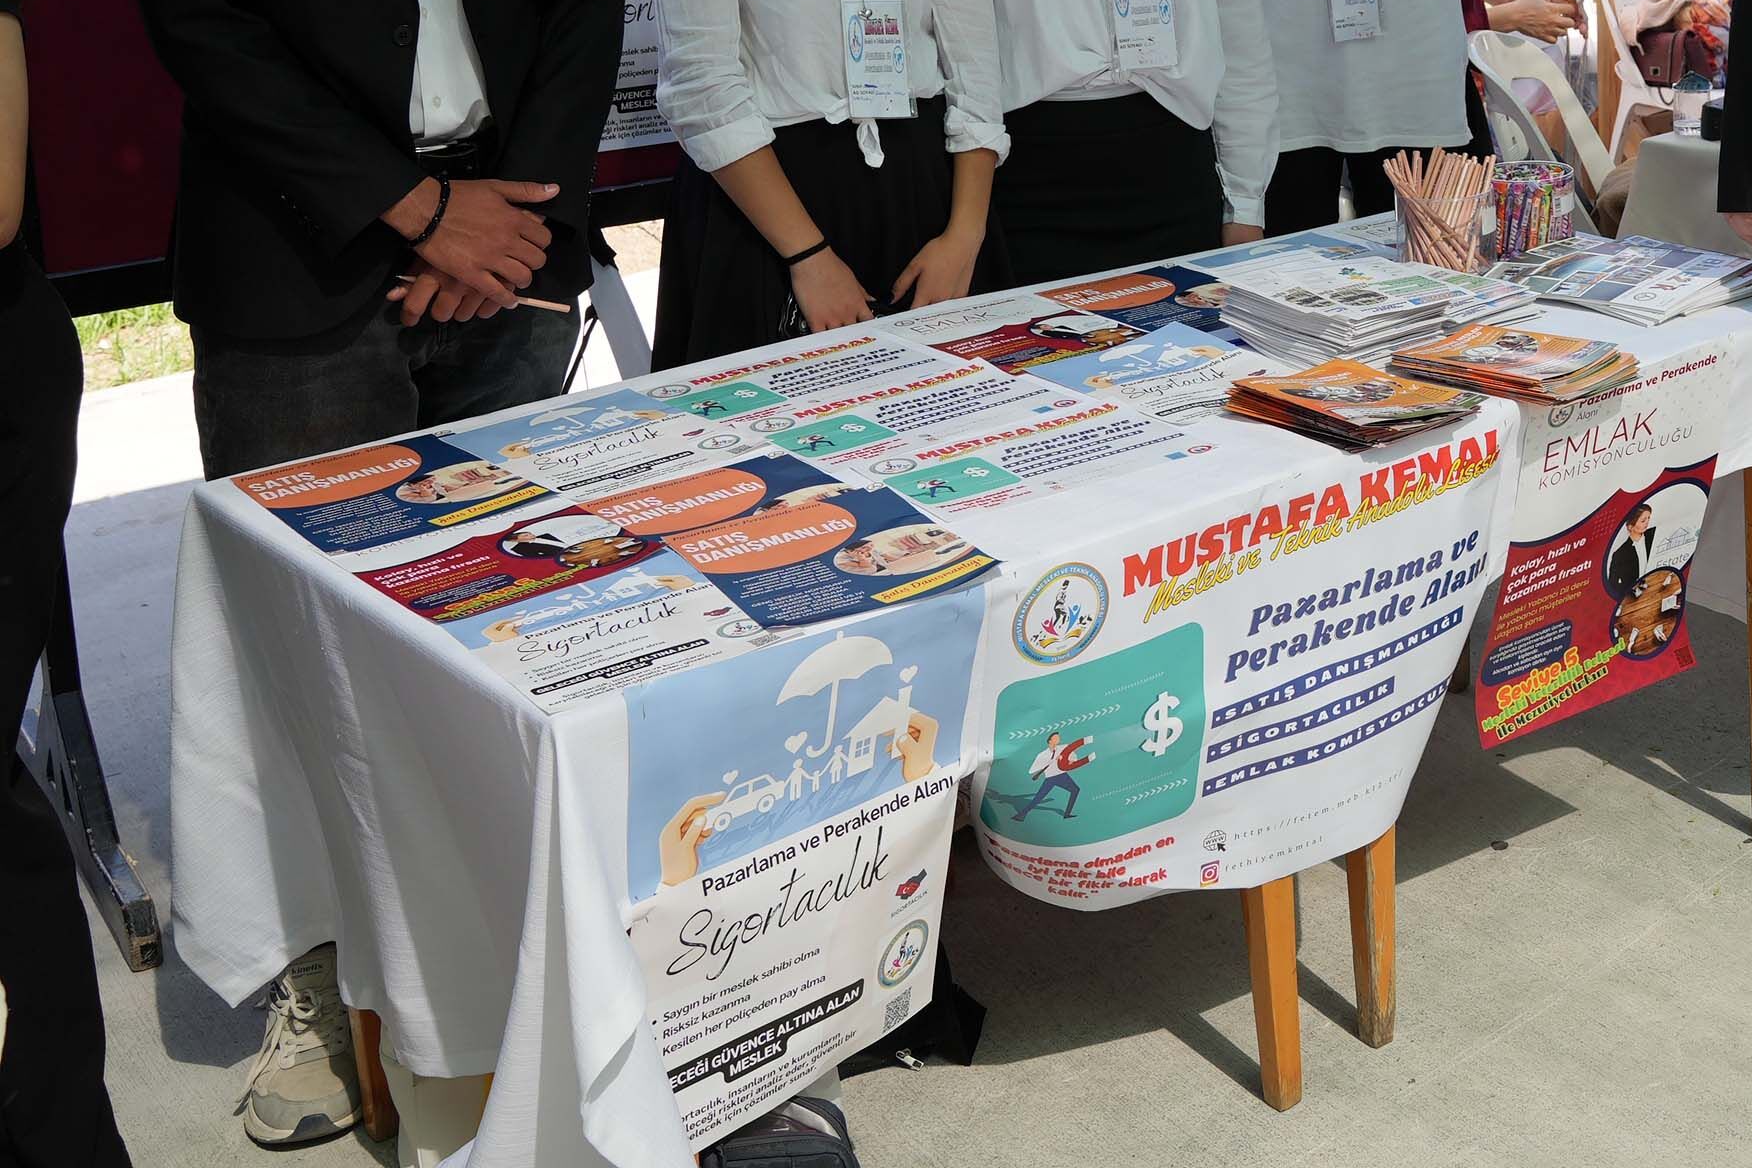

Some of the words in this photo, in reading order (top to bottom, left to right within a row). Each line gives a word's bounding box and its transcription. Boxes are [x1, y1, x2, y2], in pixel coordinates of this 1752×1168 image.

[1578, 382, 1643, 409] Pazarlama
[1645, 376, 1658, 387] ve
[1661, 354, 1718, 381] Perakende
[915, 426, 1035, 461] MUSTAFA
[1538, 425, 1693, 490] KOMİSYONCULUĞU
[1543, 407, 1658, 473] EMLAK
[259, 457, 420, 502] DANIŞMANLIĞI
[608, 481, 767, 527] DANIŞMANLIĞI
[691, 519, 855, 565] DANIŞMANLIĞI
[1122, 483, 1351, 597] MUSTAFA
[1359, 428, 1502, 506] KEMAL
[1144, 551, 1234, 623] Mesleki
[1237, 552, 1262, 577] ve
[1269, 516, 1344, 560] Teknik
[1346, 474, 1435, 535] Anadolu
[1437, 444, 1501, 495] Lisesi
[1247, 548, 1443, 637] Pazarlama
[1450, 529, 1480, 562] ve
[1503, 576, 1556, 605] kazanma
[1557, 560, 1593, 581] fırsatı
[1506, 573, 1532, 594] çok
[1530, 562, 1558, 585] para
[1510, 554, 1545, 578] Kolay,
[1547, 544, 1572, 560] hızlı
[1573, 537, 1587, 551] ve
[517, 602, 683, 662] Sigortacılık
[1223, 593, 1416, 684] Perakende
[1224, 684, 1296, 720] SATIŞ
[1304, 612, 1460, 690] DANIŞMANLIĞI
[1497, 662, 1562, 710] Seviye
[1563, 645, 1579, 670] 5
[1220, 683, 1389, 754] SİGORTACILIK
[1214, 754, 1296, 789] EMLAK
[702, 844, 796, 896] Pazarlama
[800, 835, 820, 853] ve
[822, 793, 910, 843] Perakende
[913, 775, 955, 802] Alanı
[1084, 844, 1152, 869] olmadan
[1156, 835, 1175, 849] en
[1225, 836, 1324, 872] fethiyemkmtal
[1027, 864, 1049, 876] iyi
[1053, 868, 1090, 879] fikir
[1096, 865, 1127, 879] bile
[1078, 880, 1115, 889] fikir
[1118, 868, 1168, 888] olarak
[666, 825, 890, 981] Sigortacılık
[663, 1000, 700, 1023] Saygın
[702, 992, 718, 1005] bir
[719, 975, 759, 997] meslek
[762, 958, 792, 979] sahibi
[794, 947, 821, 964] olma
[663, 1032, 703, 1056] Kesilen
[704, 1022, 724, 1036] her
[724, 996, 778, 1029] poliçeden
[780, 986, 799, 1004] pay
[800, 975, 826, 991] alma
[663, 1016, 700, 1039] Risksiz
[702, 994, 751, 1021] kazanma
[711, 1030, 775, 1069] GÜVENCE
[776, 1005, 824, 1038] ALTINA
[825, 986, 860, 1010] ALAN
[718, 1094, 754, 1114] riskleri
[755, 1078, 784, 1096] analiz
[785, 1063, 809, 1081] eder,
[811, 1042, 844, 1064] güvenli
[845, 1030, 857, 1043] bir
[728, 1069, 776, 1097] insanların
[778, 1062, 790, 1072] ve
[791, 1033, 841, 1065] kurumların
[729, 1041, 783, 1077] MESLEK
[724, 1108, 743, 1122] için
[743, 1083, 789, 1112] çözümler
[790, 1066, 818, 1085] sunar.
